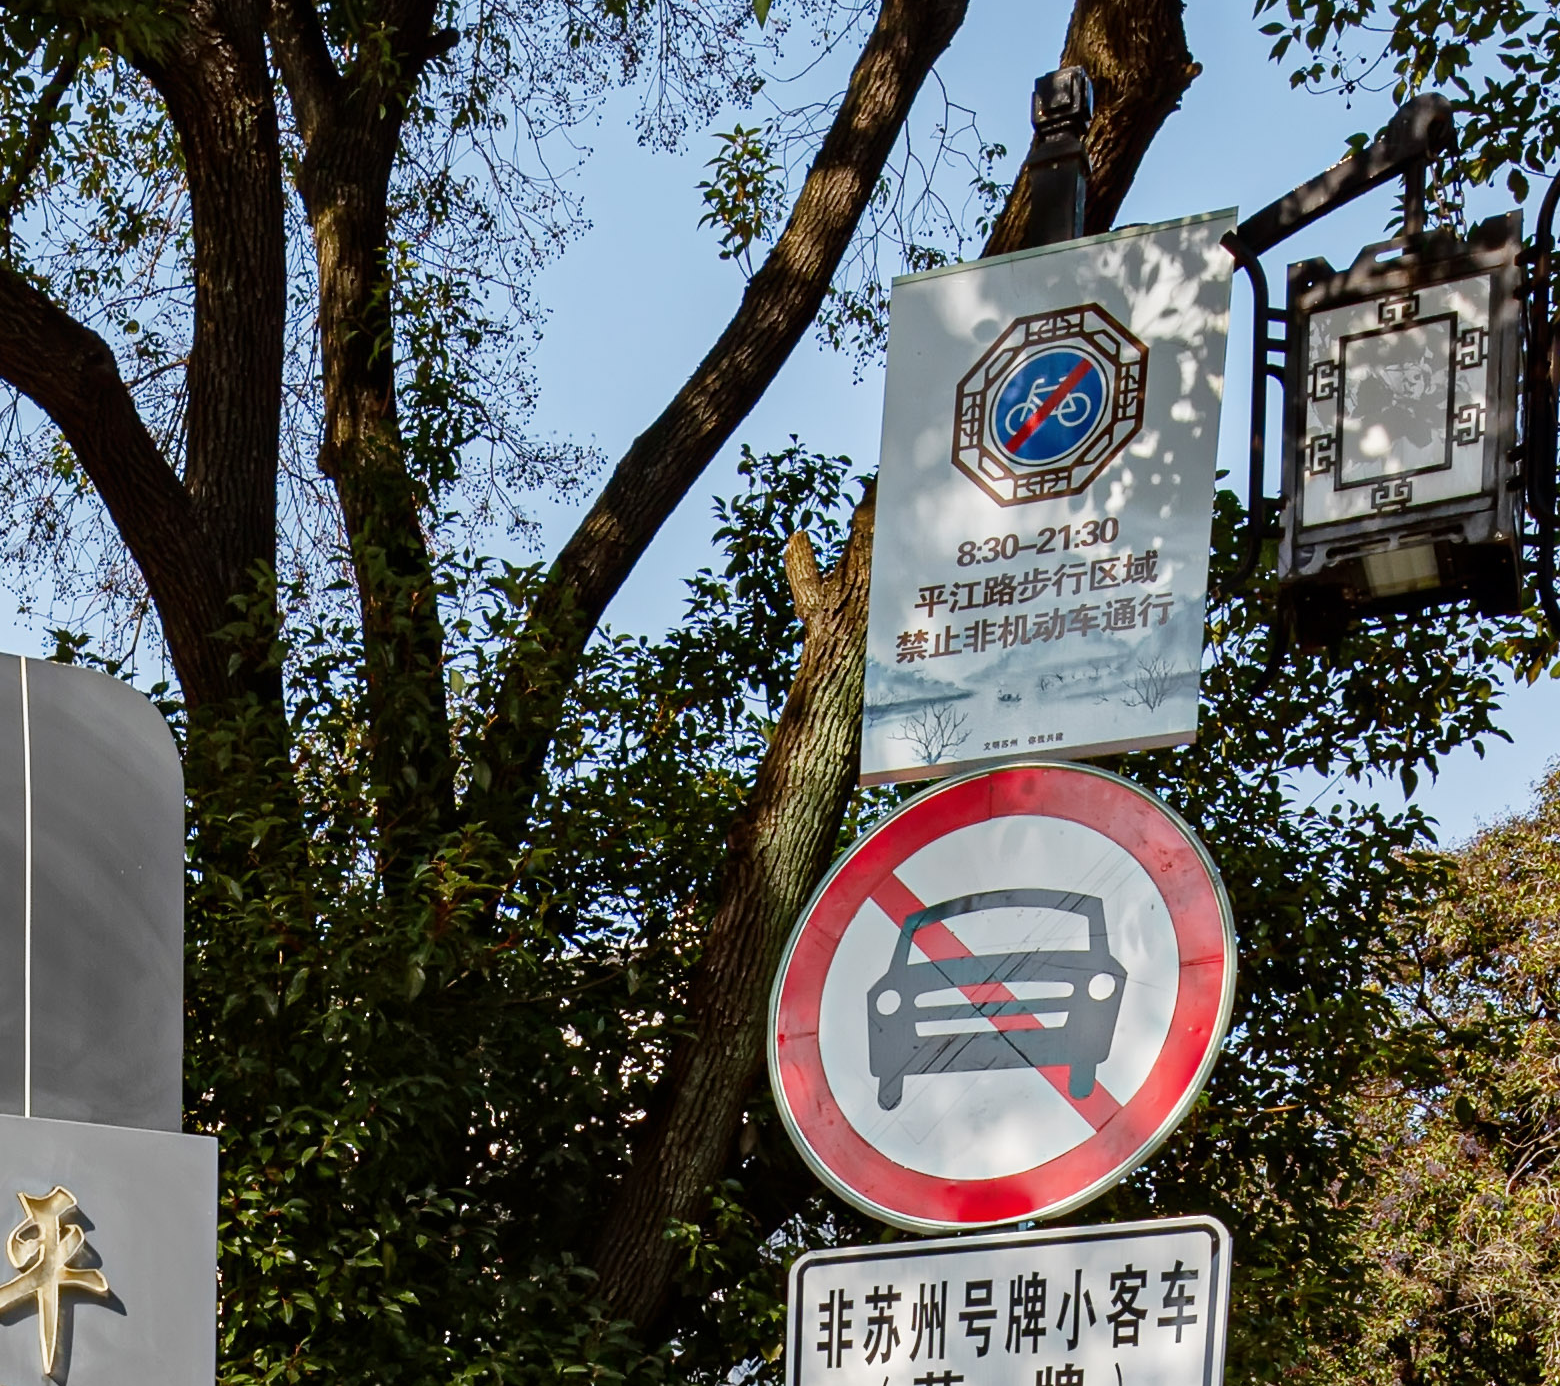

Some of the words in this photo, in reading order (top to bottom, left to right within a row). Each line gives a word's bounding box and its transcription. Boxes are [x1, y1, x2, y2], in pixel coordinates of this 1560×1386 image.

[915, 550, 1159, 618] 平江路步行区域
[896, 592, 1175, 664] 禁止非机动车通行
[817, 1260, 1199, 1369] 非苏州号牌小客车
